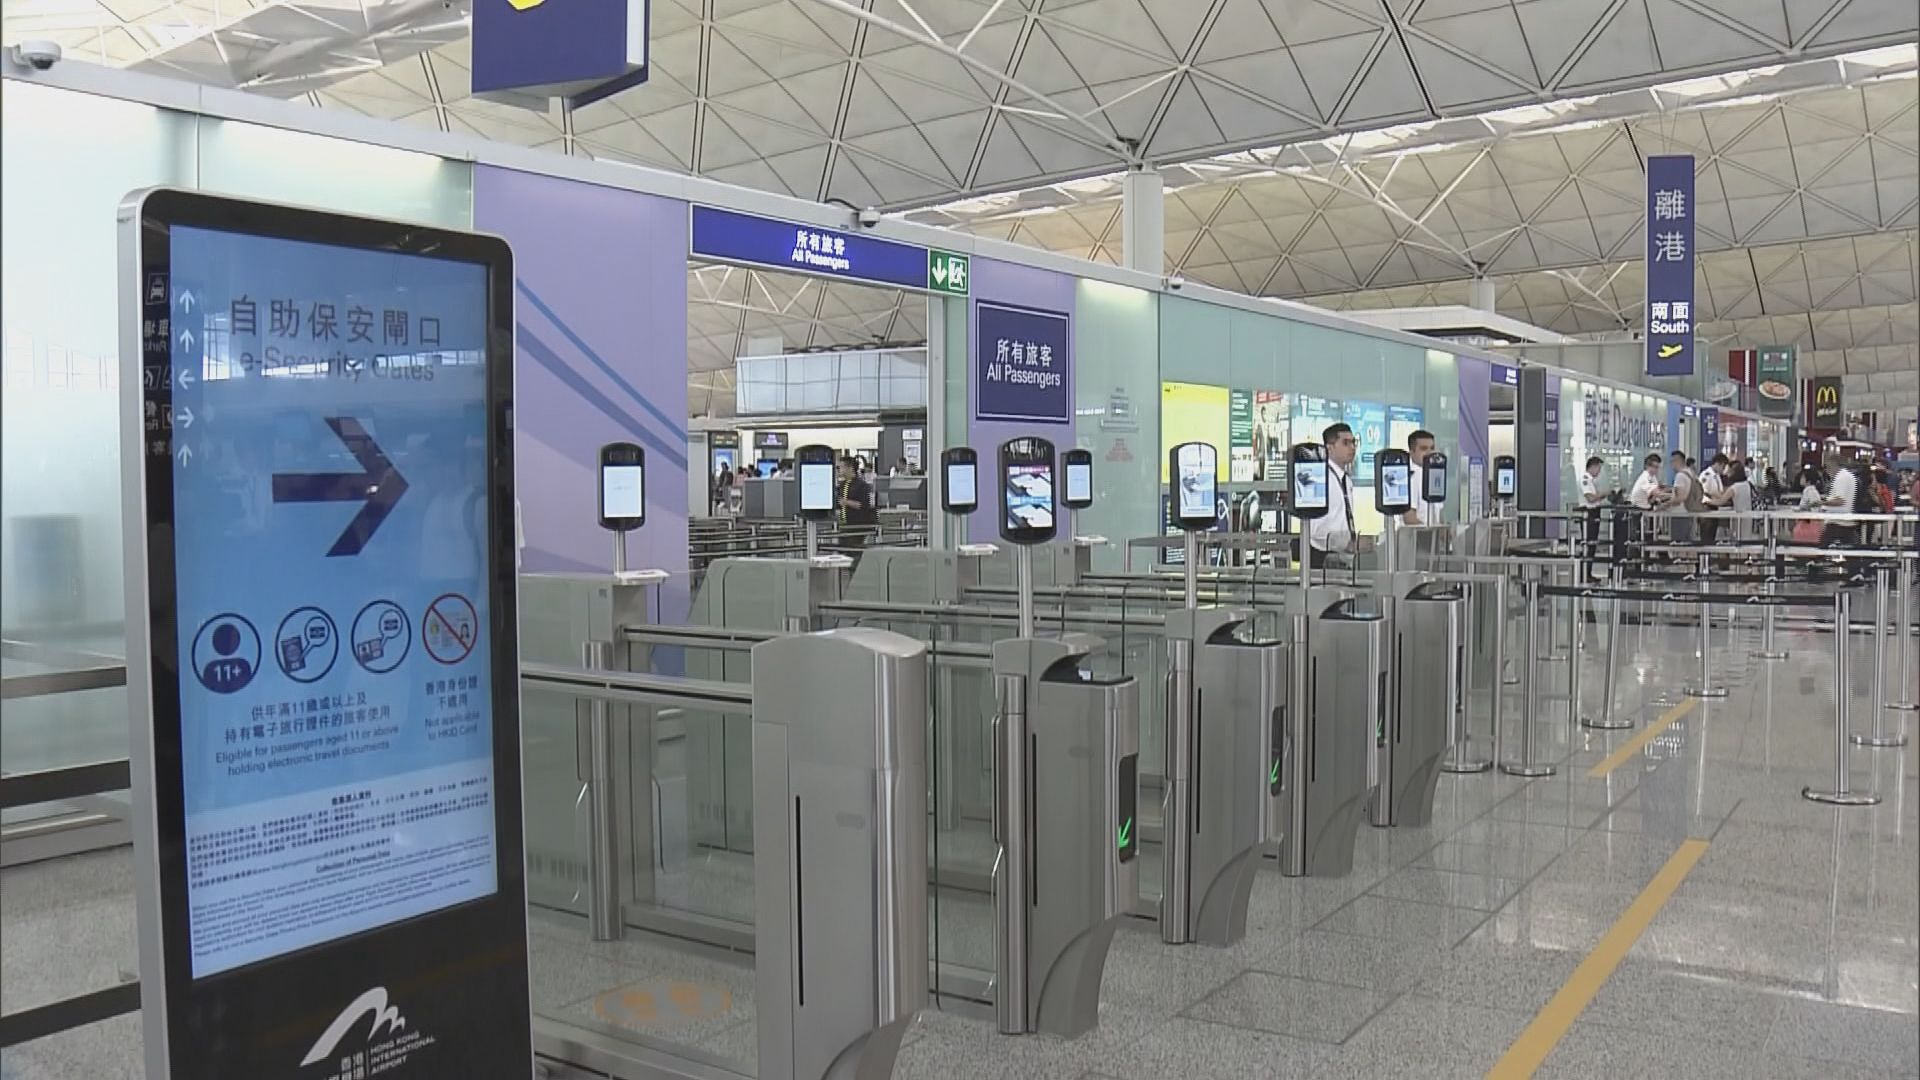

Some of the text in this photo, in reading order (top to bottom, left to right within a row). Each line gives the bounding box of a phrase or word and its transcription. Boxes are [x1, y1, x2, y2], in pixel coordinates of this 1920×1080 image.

[1655, 189, 1686, 261] 離港
[796, 230, 845, 256] 所有旅客
[791, 248, 850, 271] All Passengers
[230, 294, 442, 347] 自助保安閘口
[1651, 301, 1689, 320] 南面
[1651, 321, 1689, 334] South
[240, 347, 435, 383] e-Security Gates
[996, 338, 1052, 367] 所有旅客
[986, 362, 1061, 389] All Passengers
[1585, 389, 1609, 445] 離港
[1613, 404, 1665, 450] Departures
[213, 663, 242, 682] 11+
[251, 691, 367, 722] 供年滿11歲或以上及
[425, 717, 439, 728] Not
[215, 724, 399, 765] Eligible for passengers aged 11 or above
[228, 741, 390, 776] holding electronic travel documents
[370, 1030, 420, 1054] HONG KONG
[370, 1035, 435, 1064] INTERNATIONAL
[371, 1055, 408, 1075] AIRPORT
